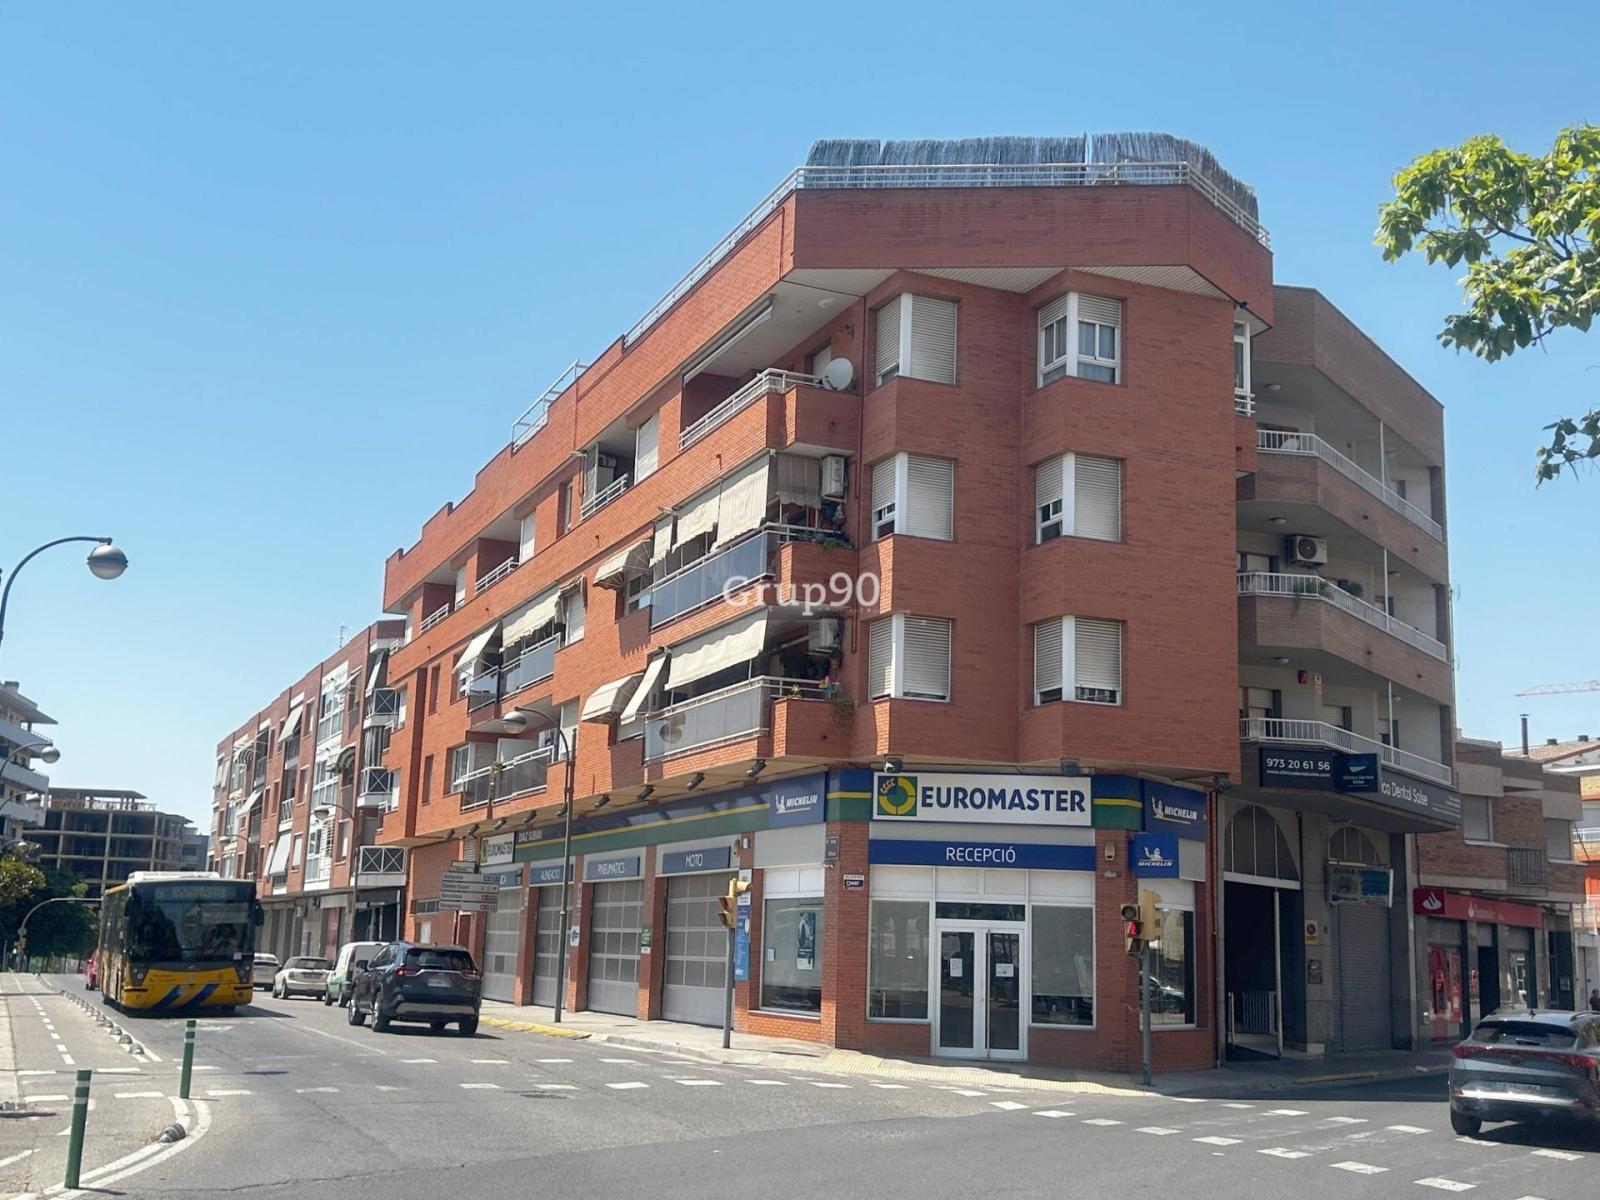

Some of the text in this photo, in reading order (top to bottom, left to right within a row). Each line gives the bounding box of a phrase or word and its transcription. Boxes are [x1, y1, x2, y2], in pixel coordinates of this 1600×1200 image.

[1266, 758, 1331, 771] 973 20 61 56
[785, 794, 818, 808] MICHELIN
[921, 786, 1086, 813] EUROMASTER
[1164, 805, 1198, 821] MICHELIN
[685, 853, 703, 868] MOTO
[946, 846, 1016, 863] RECEPCIÓ
